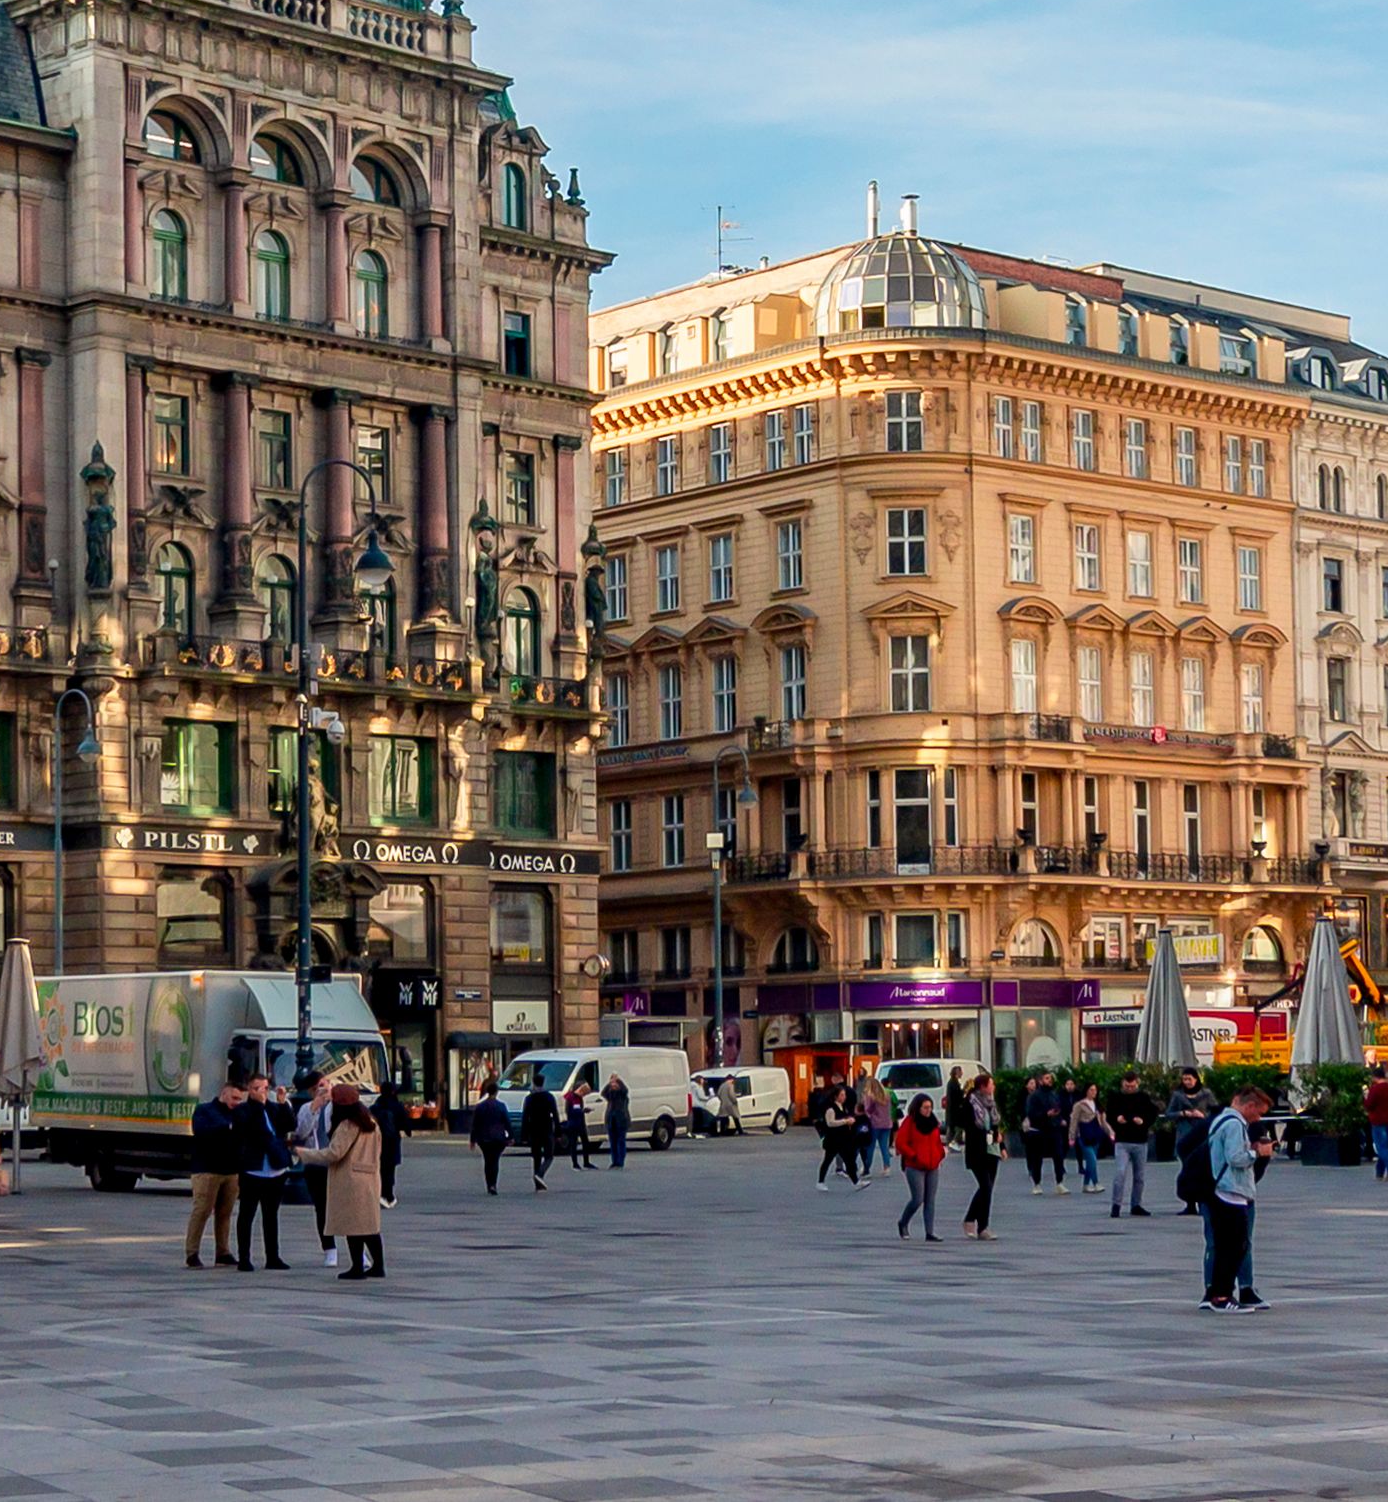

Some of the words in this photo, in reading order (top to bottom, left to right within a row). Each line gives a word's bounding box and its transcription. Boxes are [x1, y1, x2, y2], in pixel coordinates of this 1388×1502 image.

[144, 831, 233, 852] PILSTL
[376, 843, 436, 863] OMEGA
[500, 854, 555, 872] OMEGA
[889, 986, 945, 1000] Marionnaud
[85, 1100, 101, 1113] DAS
[131, 1102, 149, 1115] AUS
